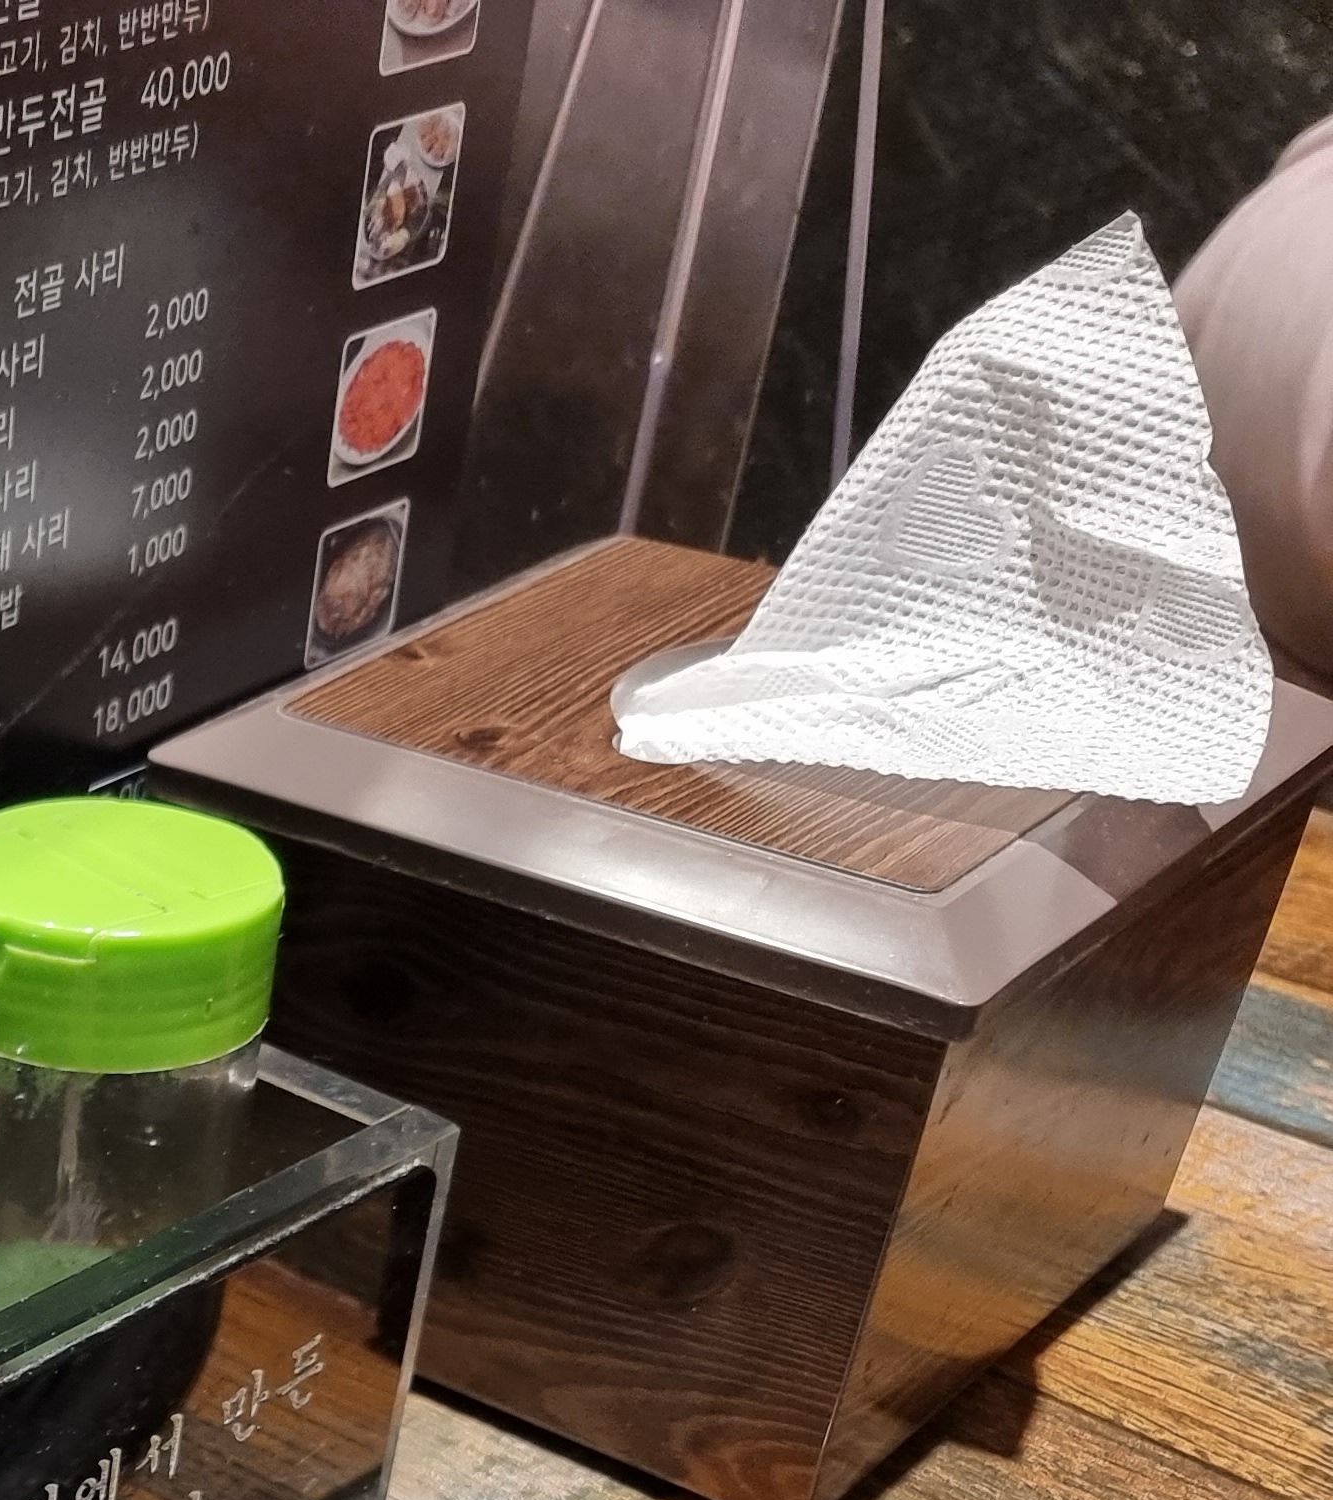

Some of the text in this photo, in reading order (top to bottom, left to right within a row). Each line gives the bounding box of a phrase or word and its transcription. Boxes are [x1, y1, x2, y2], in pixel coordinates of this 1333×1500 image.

[60, 18, 107, 67] 김치,
[118, 0, 211, 51] 반반만두)
[140, 50, 231, 112] 40,000
[49, 150, 98, 199] 김치,
[108, 121, 201, 182] 반반만두)
[12, 243, 126, 322] 전골 사리
[145, 287, 210, 342] 2,000
[140, 349, 205, 403] 2,000
[135, 410, 199, 464] 2,000
[20, 509, 71, 561] 사리
[131, 467, 193, 519] 7,000
[127, 525, 187, 577] 1,000
[97, 617, 179, 679] 14,000
[92, 674, 174, 738] 18,000
[222, 1333, 327, 1442] 만든
